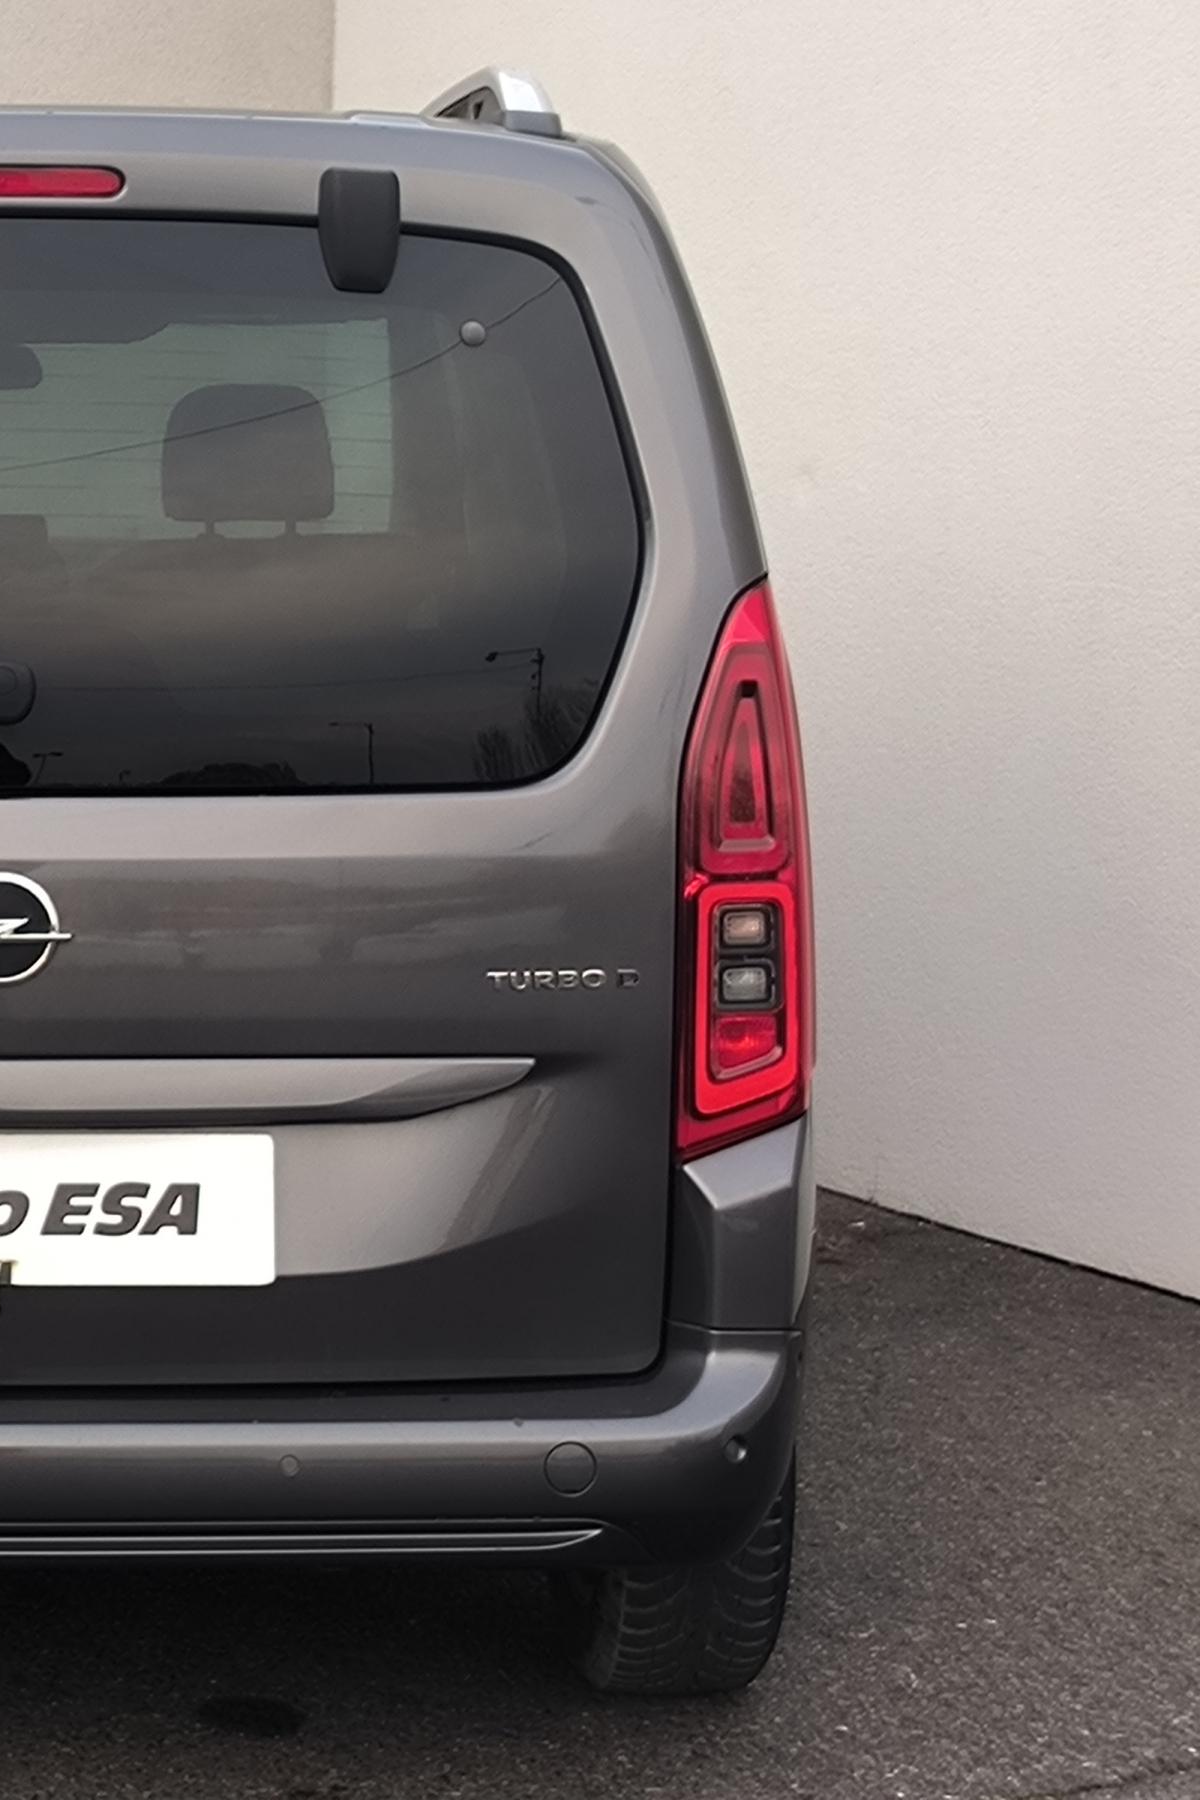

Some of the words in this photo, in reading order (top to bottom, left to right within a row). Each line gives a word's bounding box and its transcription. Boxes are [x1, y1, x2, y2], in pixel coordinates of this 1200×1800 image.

[486, 968, 607, 990] TURBO
[616, 968, 640, 988] D
[40, 1182, 201, 1236] ESA
